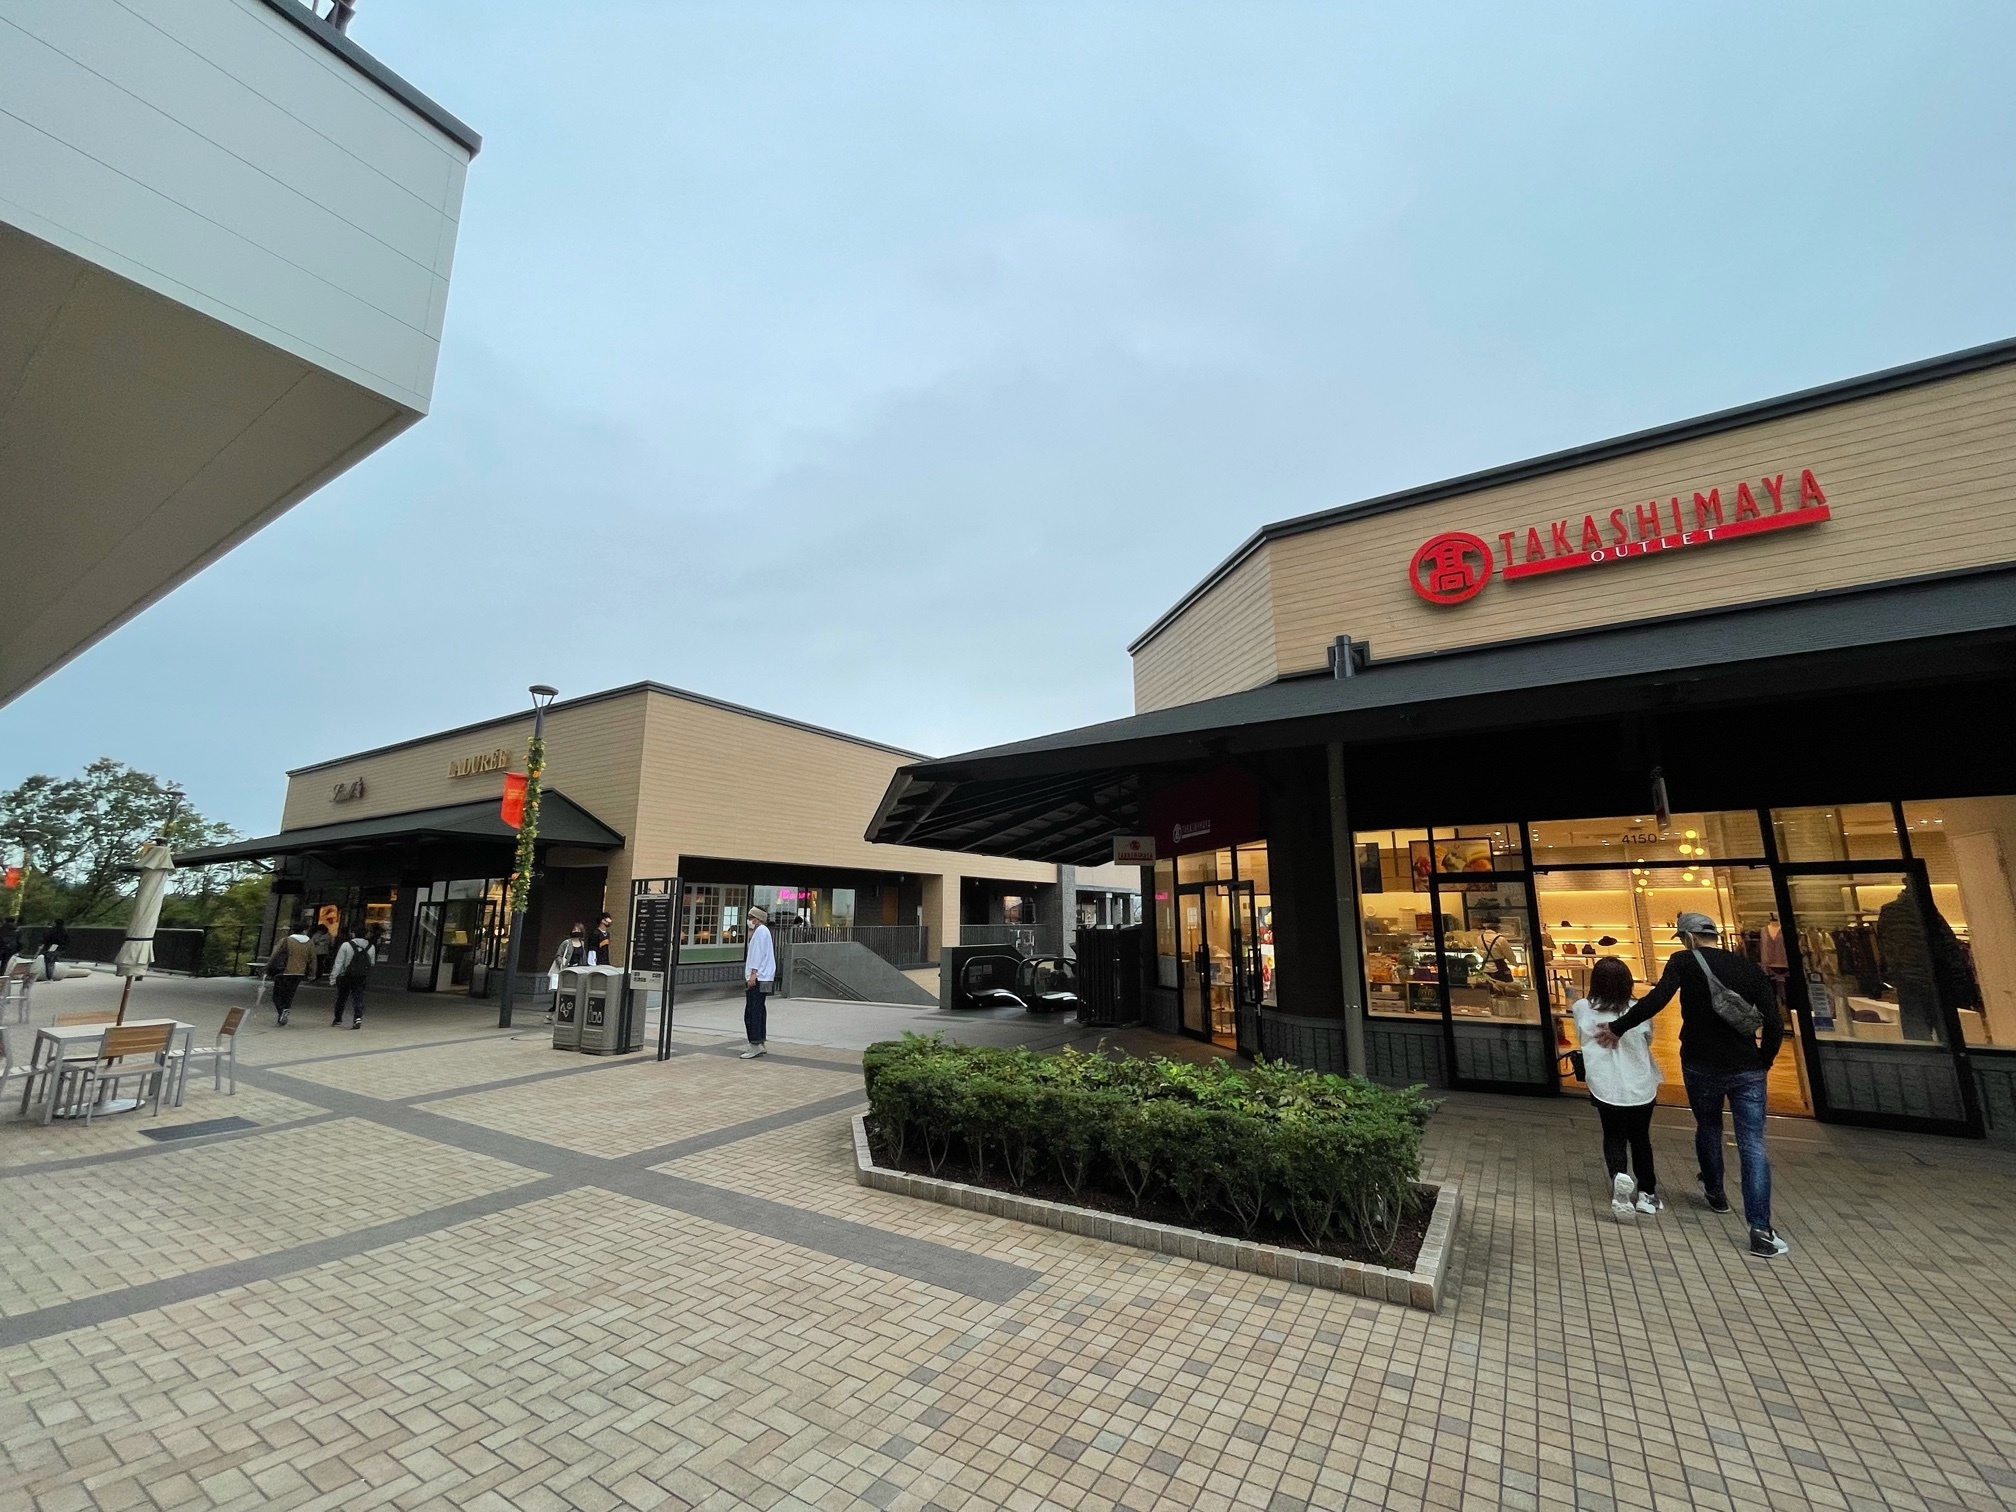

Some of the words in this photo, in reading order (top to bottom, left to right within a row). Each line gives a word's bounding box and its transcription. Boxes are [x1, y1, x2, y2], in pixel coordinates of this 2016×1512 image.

[1498, 468, 1827, 566] TAKASHIMAYA
[1590, 528, 1718, 562] OUTLET
[447, 748, 508, 778] LADURÉE
[1622, 833, 1657, 844] 4150
